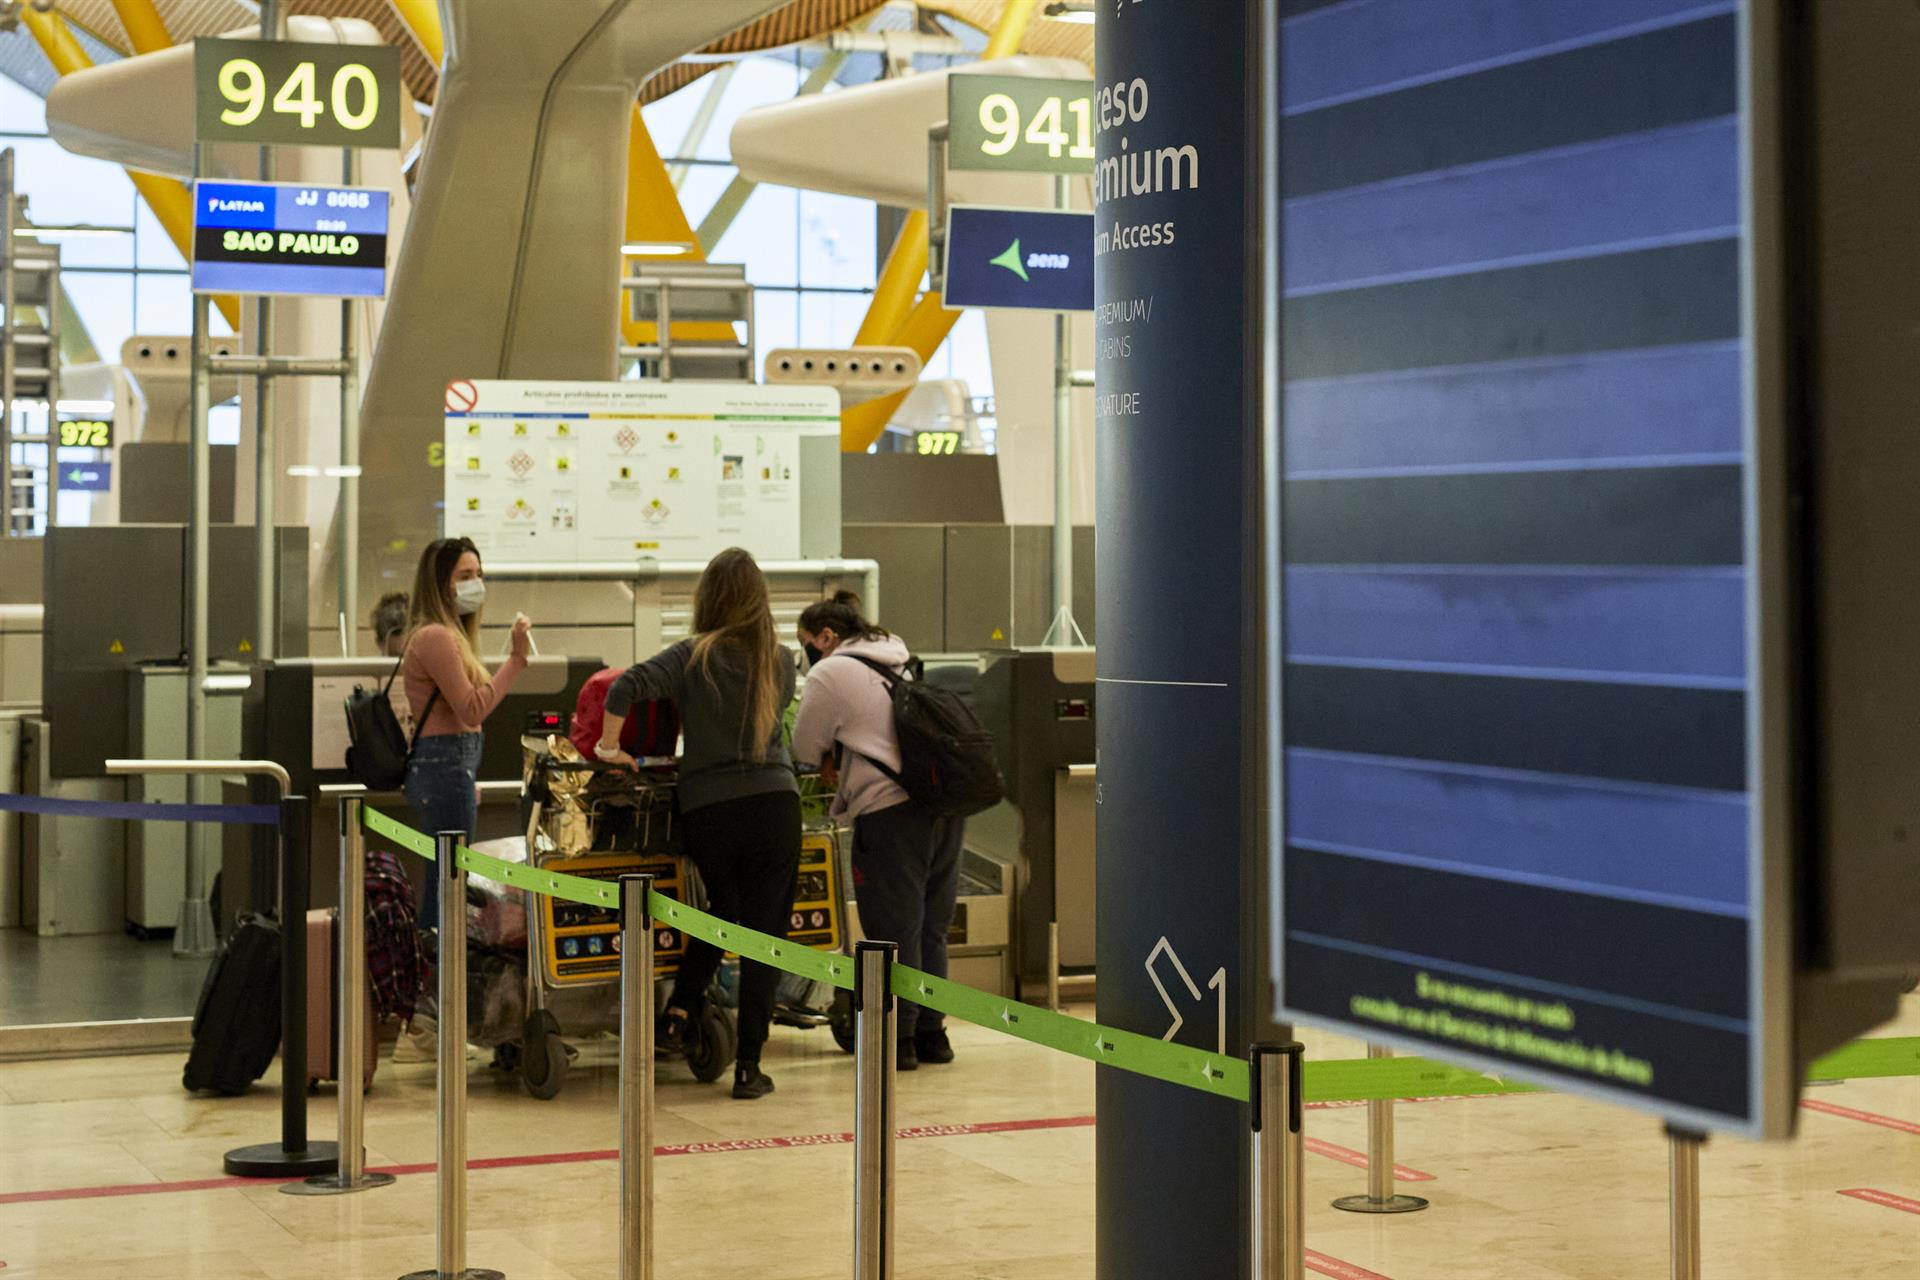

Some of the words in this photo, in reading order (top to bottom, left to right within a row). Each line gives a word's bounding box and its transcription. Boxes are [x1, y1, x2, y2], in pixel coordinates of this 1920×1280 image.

[218, 58, 379, 130] 940
[979, 93, 1095, 158] 941
[219, 199, 264, 213] LATAM
[295, 190, 318, 206] JJ
[223, 231, 274, 252] SAO
[279, 233, 359, 255] PAULO
[1112, 221, 1175, 251] Access
[1027, 253, 1069, 269] aena
[61, 421, 109, 447] 972
[917, 432, 959, 455] 977
